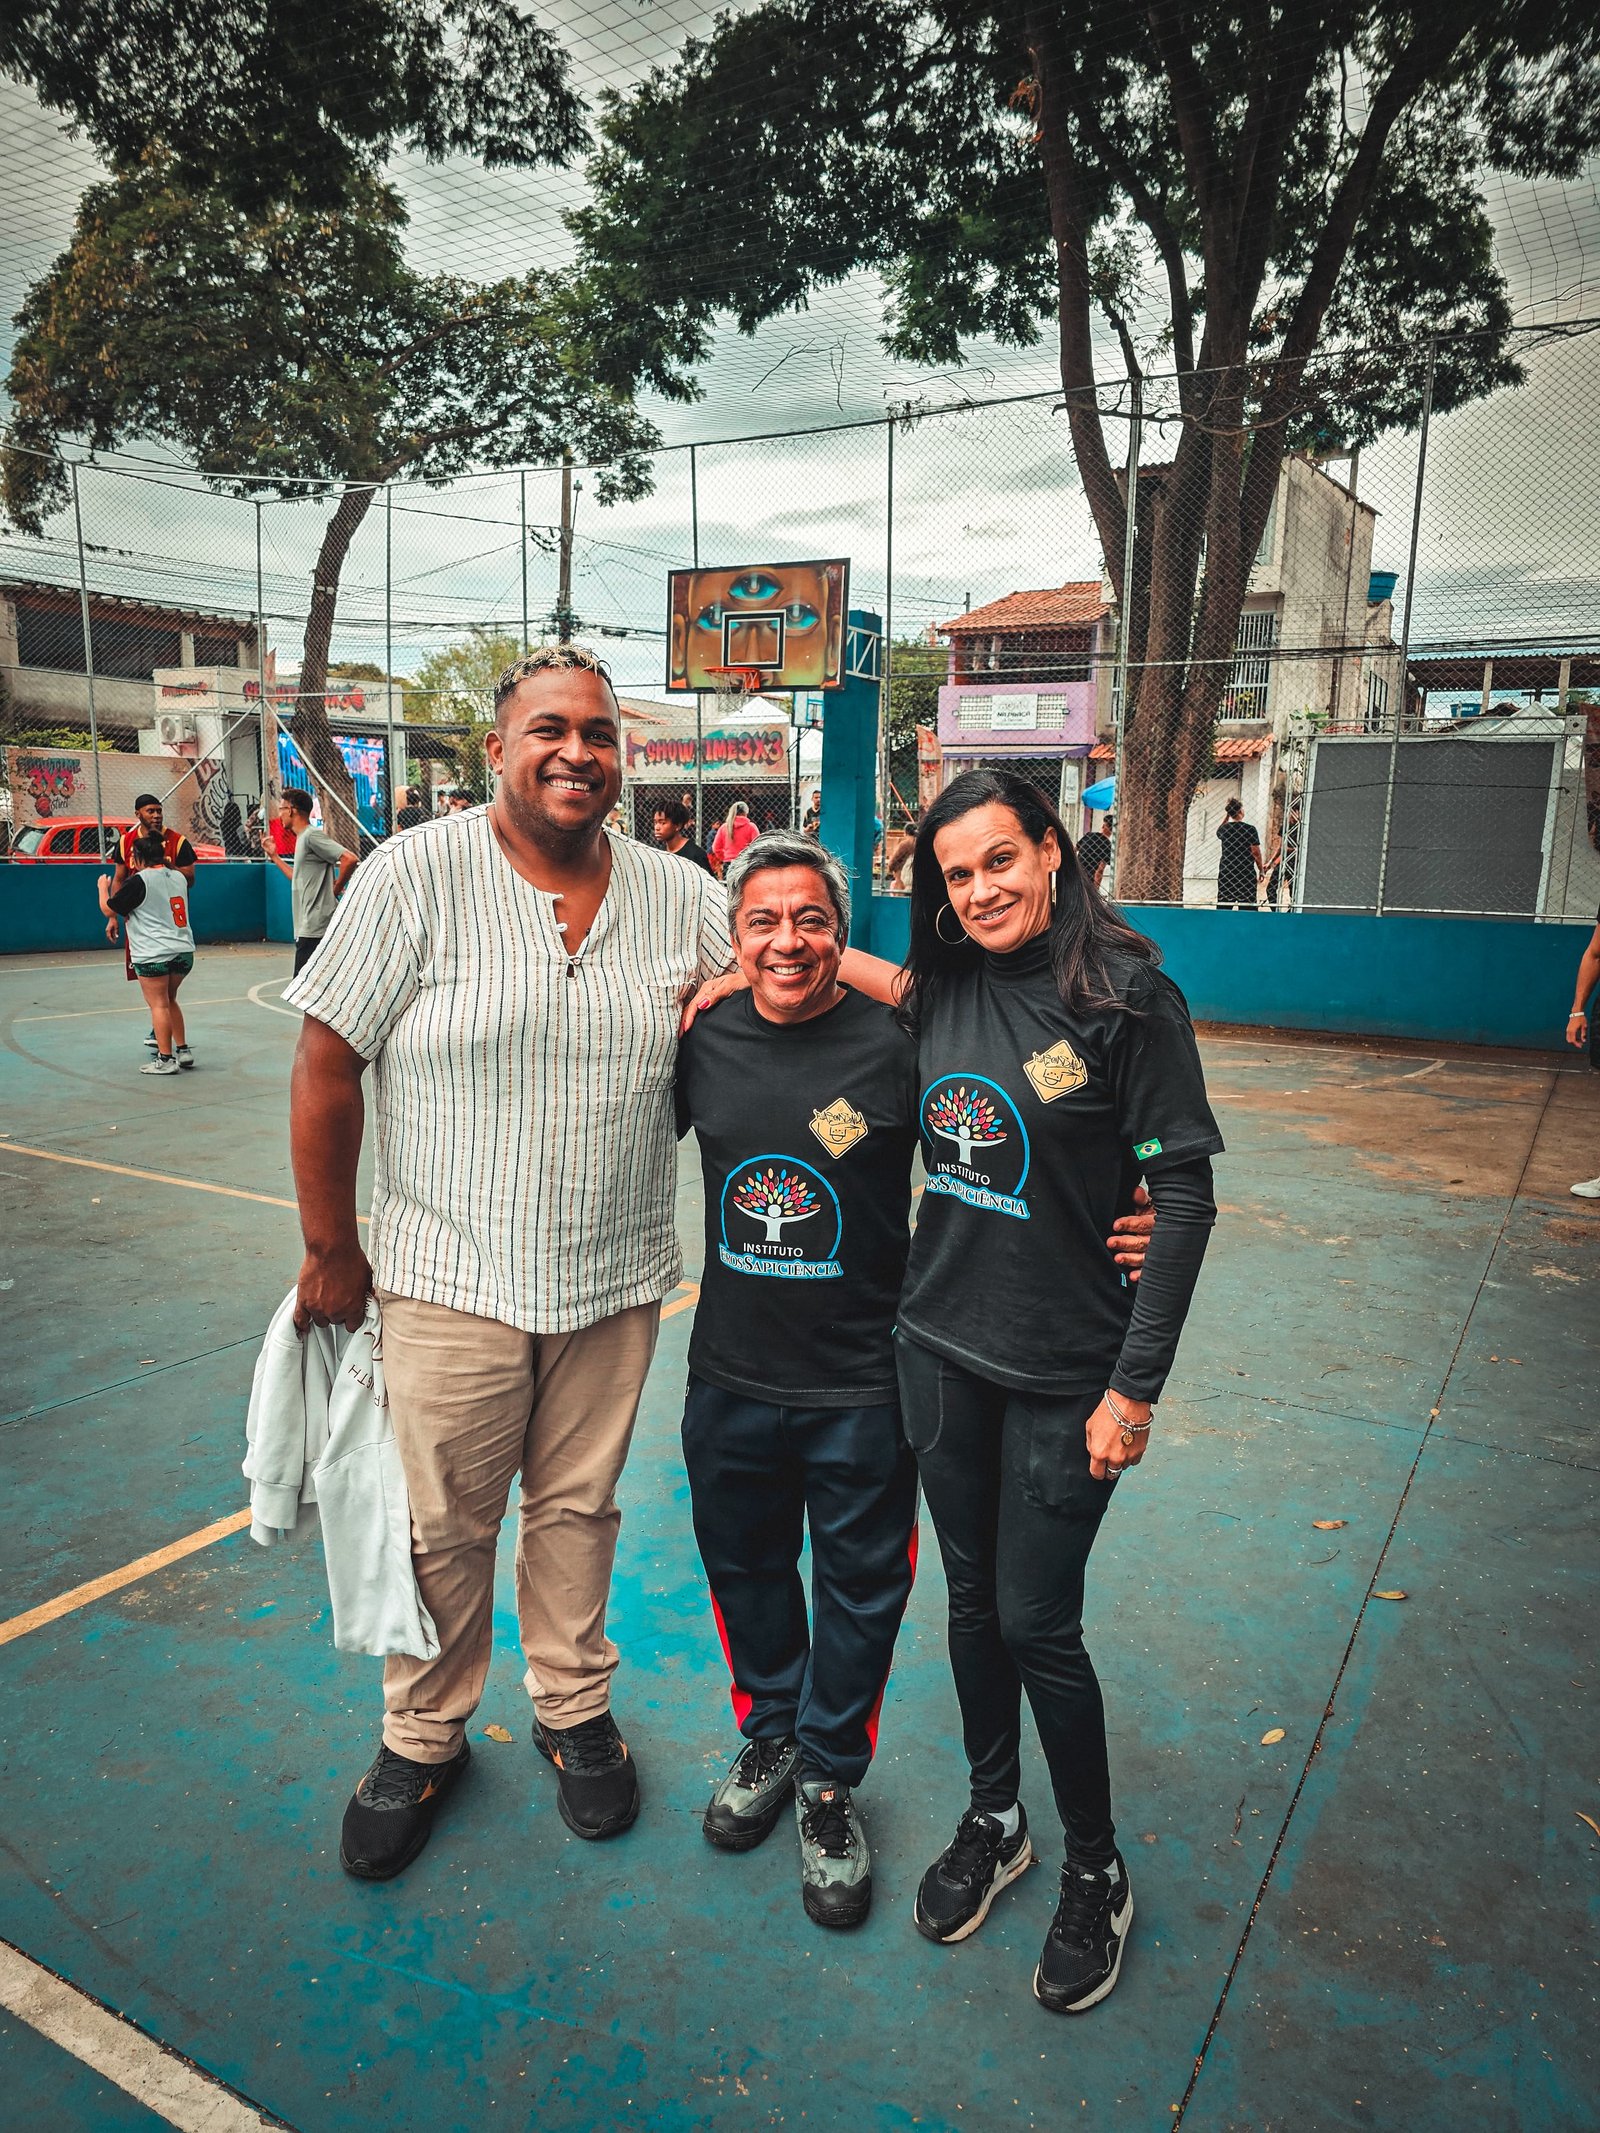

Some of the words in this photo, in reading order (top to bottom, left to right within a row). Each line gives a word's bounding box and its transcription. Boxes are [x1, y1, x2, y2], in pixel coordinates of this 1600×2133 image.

[169, 895, 187, 928] 8
[937, 1162, 991, 1186] INSTITUTO
[743, 1242, 804, 1258] INSTITUTO
